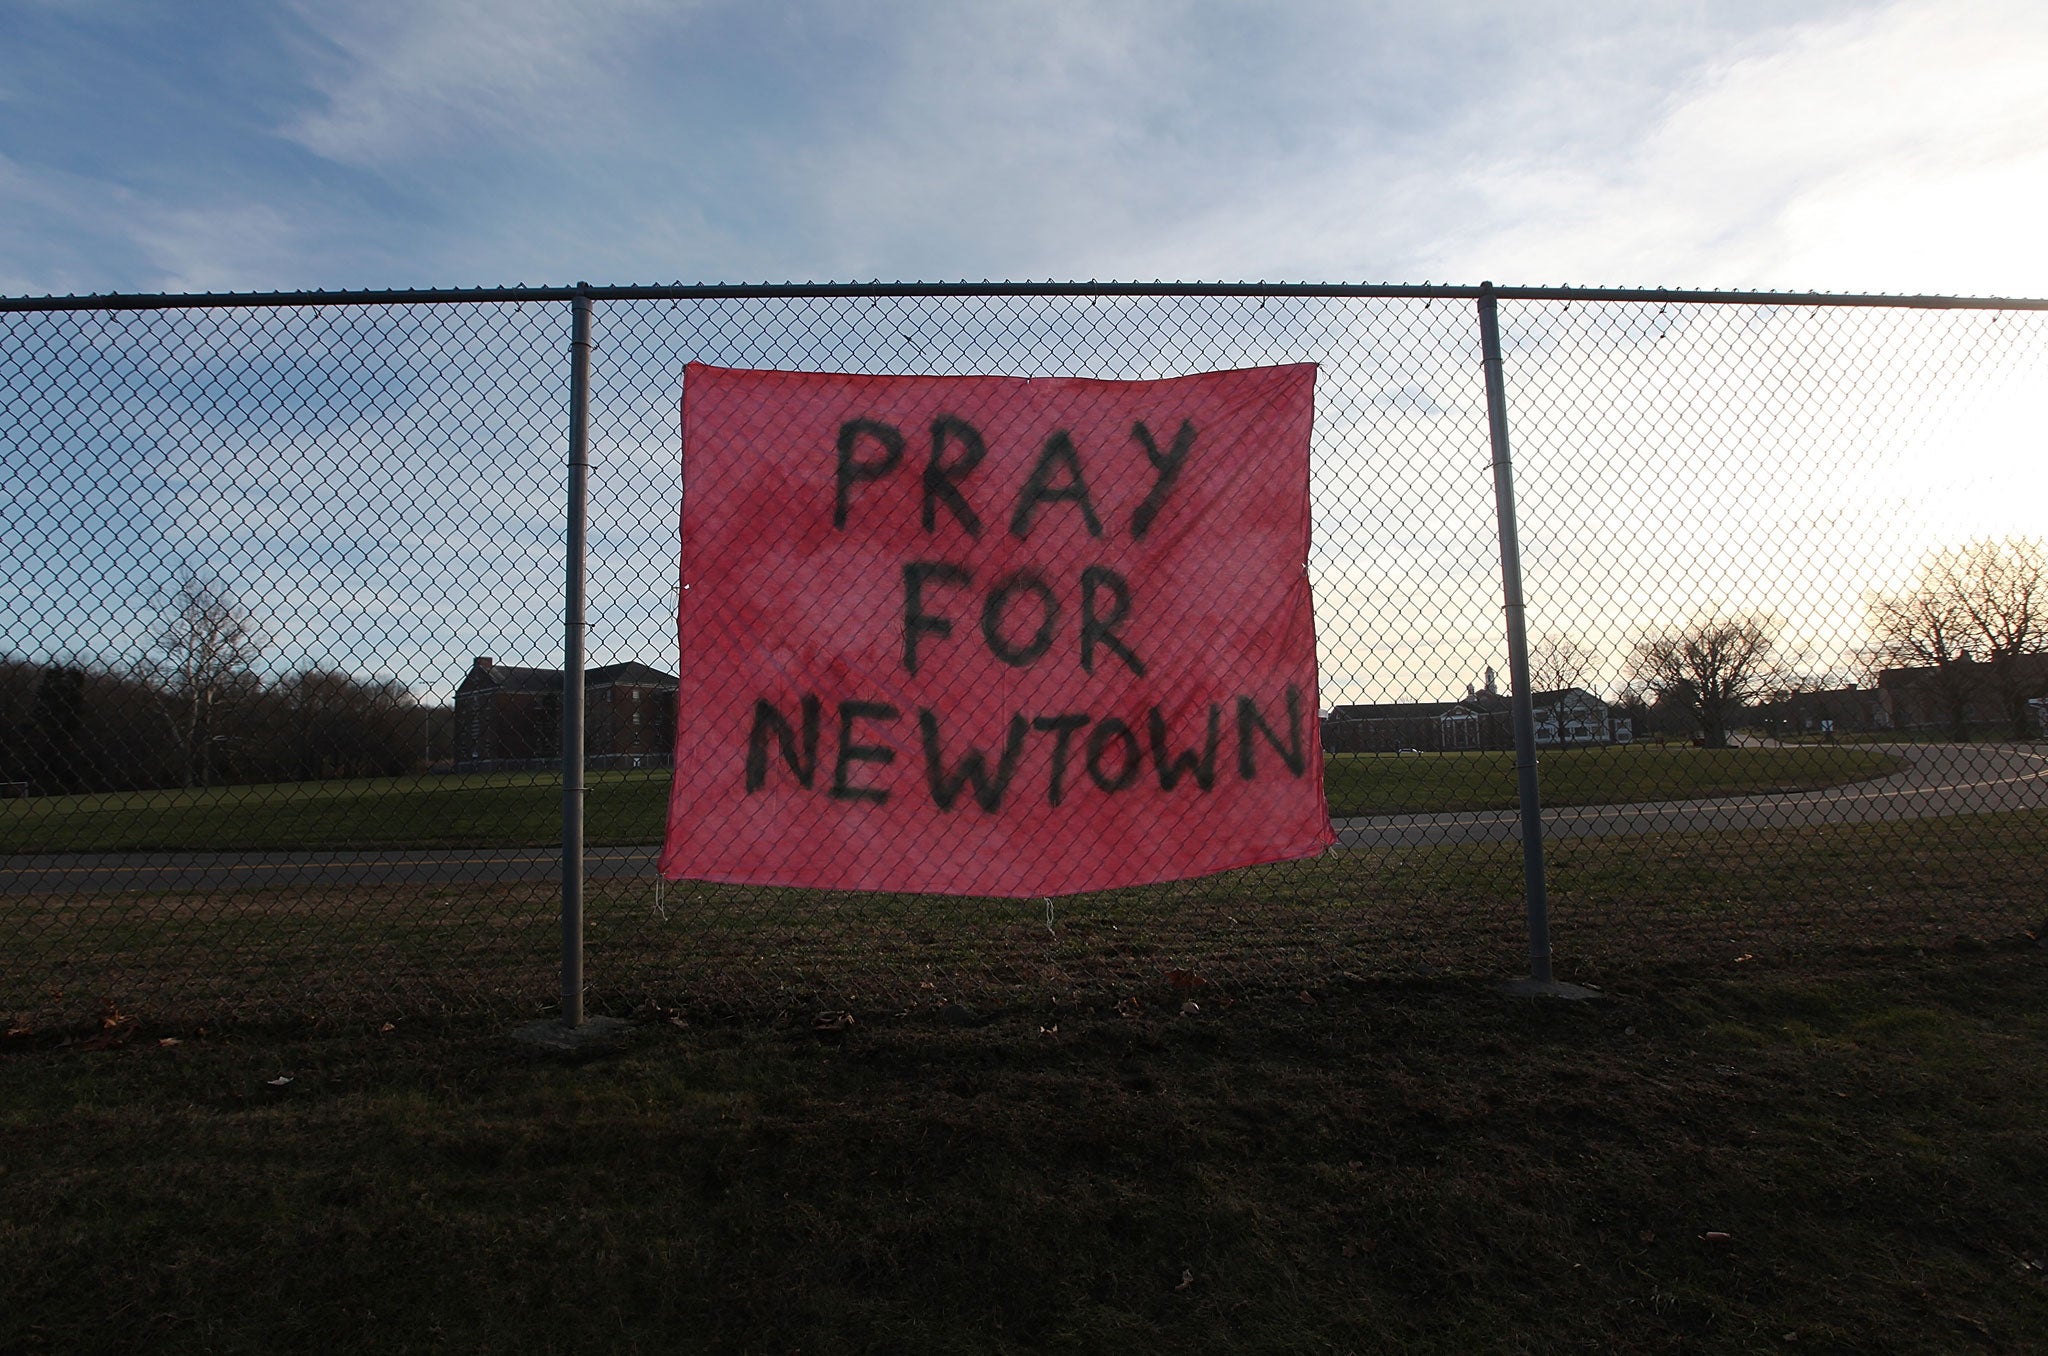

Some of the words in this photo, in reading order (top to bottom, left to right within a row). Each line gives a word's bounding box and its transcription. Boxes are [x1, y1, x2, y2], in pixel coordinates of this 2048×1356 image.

[833, 413, 1197, 540] PRAY
[903, 561, 1146, 677] FOR
[746, 685, 1306, 814] NEWTOWN
